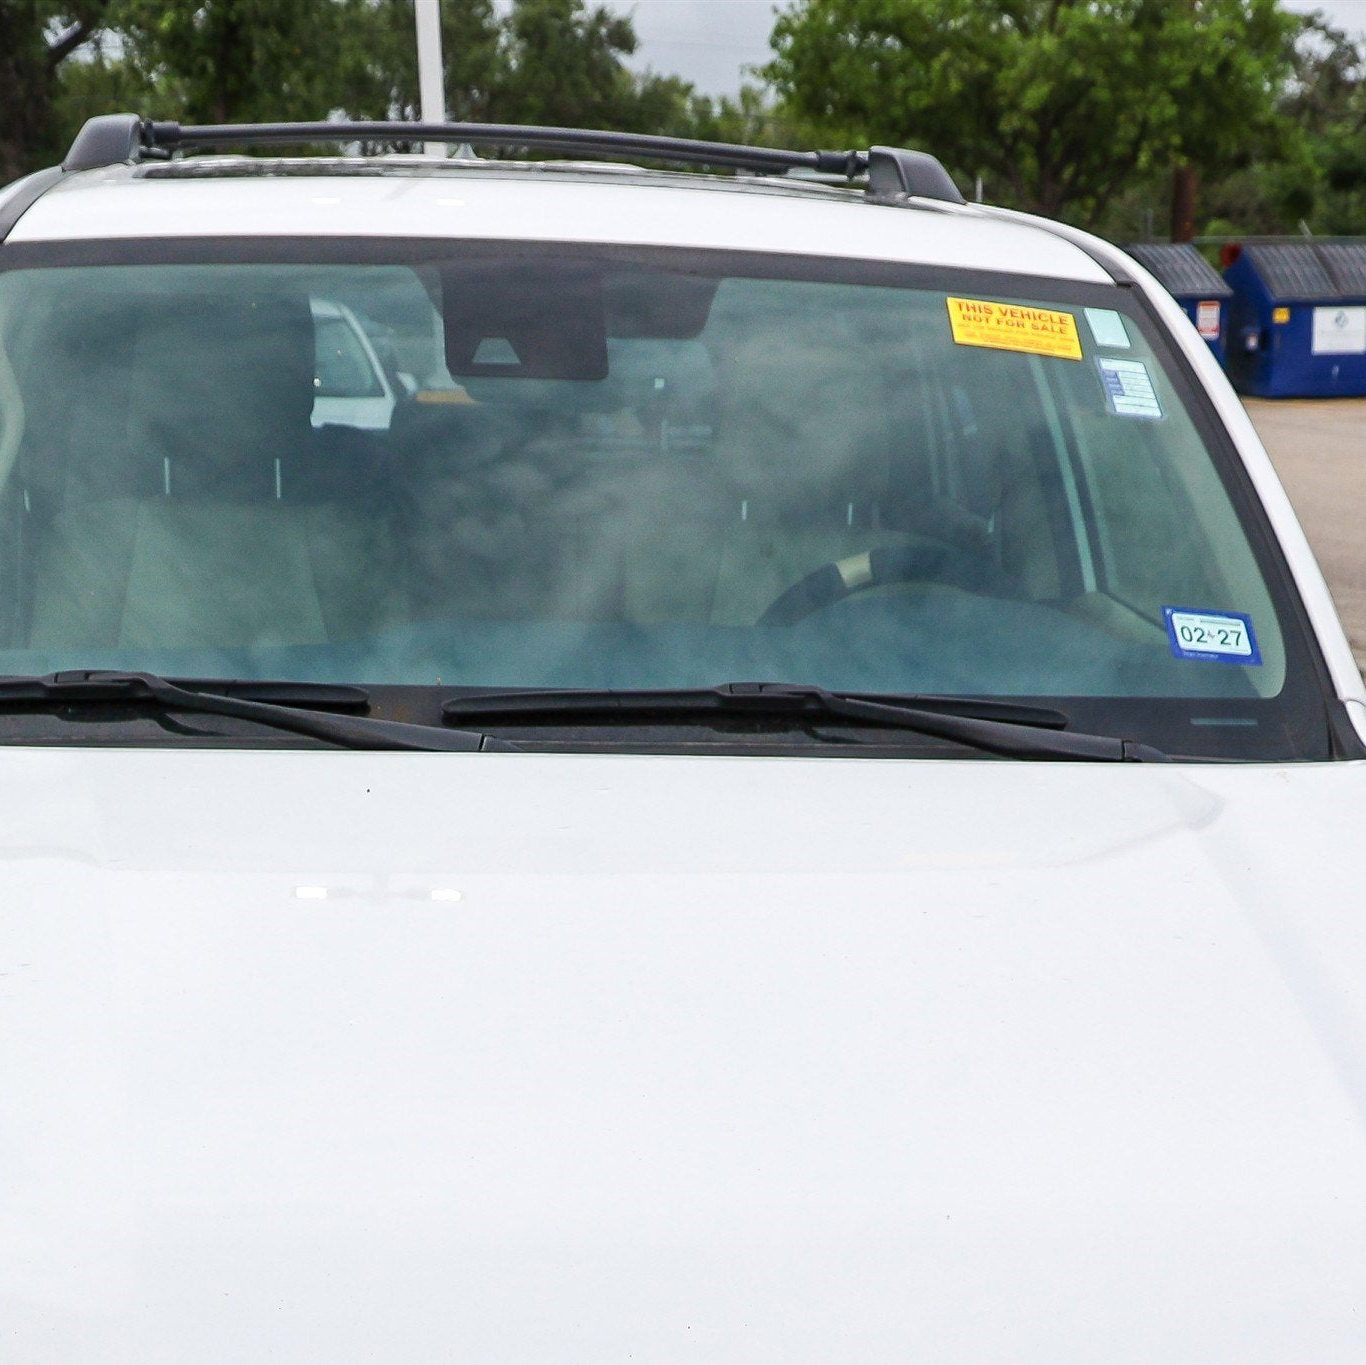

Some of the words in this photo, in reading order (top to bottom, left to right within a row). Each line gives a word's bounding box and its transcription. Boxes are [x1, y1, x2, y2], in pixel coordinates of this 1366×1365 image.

[955, 301, 993, 315] THIS
[998, 306, 1069, 326] VEHICLE
[962, 313, 990, 325] NOT
[996, 318, 1025, 329] FOR
[1031, 322, 1067, 335] SALE
[1180, 625, 1208, 644] 02
[1217, 628, 1242, 647] 27
